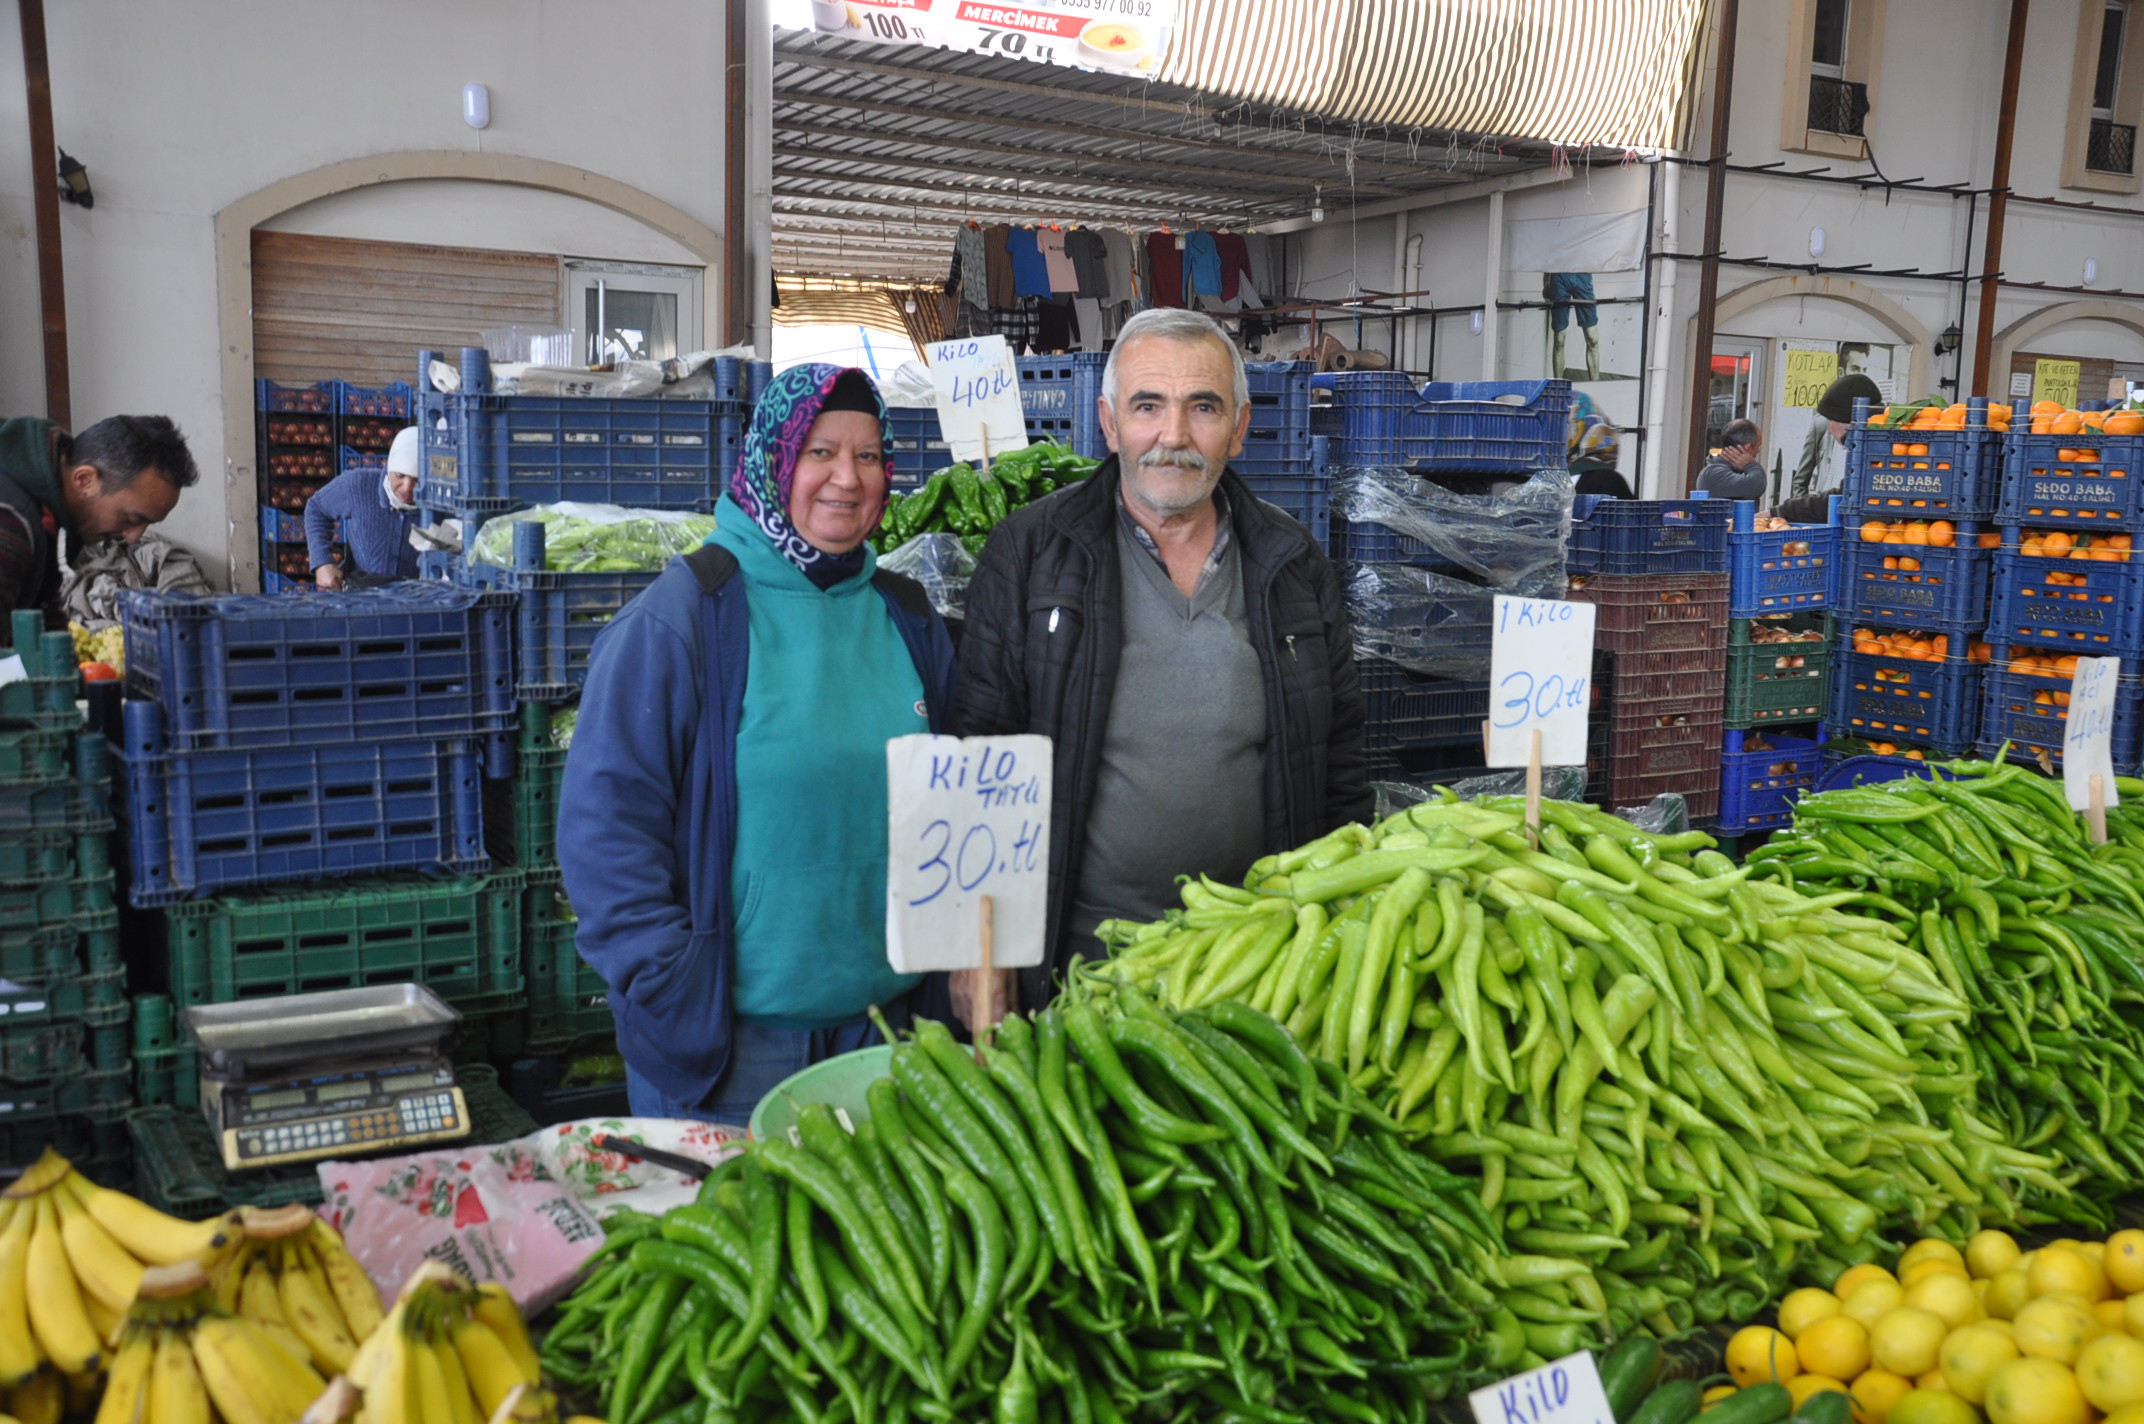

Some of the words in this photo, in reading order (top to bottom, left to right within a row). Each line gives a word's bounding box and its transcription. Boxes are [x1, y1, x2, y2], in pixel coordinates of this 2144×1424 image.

[1119, 0, 1134, 14] 00
[1137, 1, 1152, 16] 92
[863, 11, 908, 39] 100
[963, 5, 1060, 32] MERCİMEK
[977, 26, 1028, 54] 70
[1034, 44, 1057, 60] TL
[1784, 374, 1793, 390] 3
[1792, 382, 1828, 407] 1000
[1872, 473, 1904, 485] SEDO
[1907, 475, 1942, 487] BABA
[2034, 482, 2071, 494] SEDO
[2075, 483, 2116, 496] BABA
[1901, 587, 1934, 600] BABA
[1500, 600, 1509, 634] 1
[2064, 606, 2105, 620] BABA
